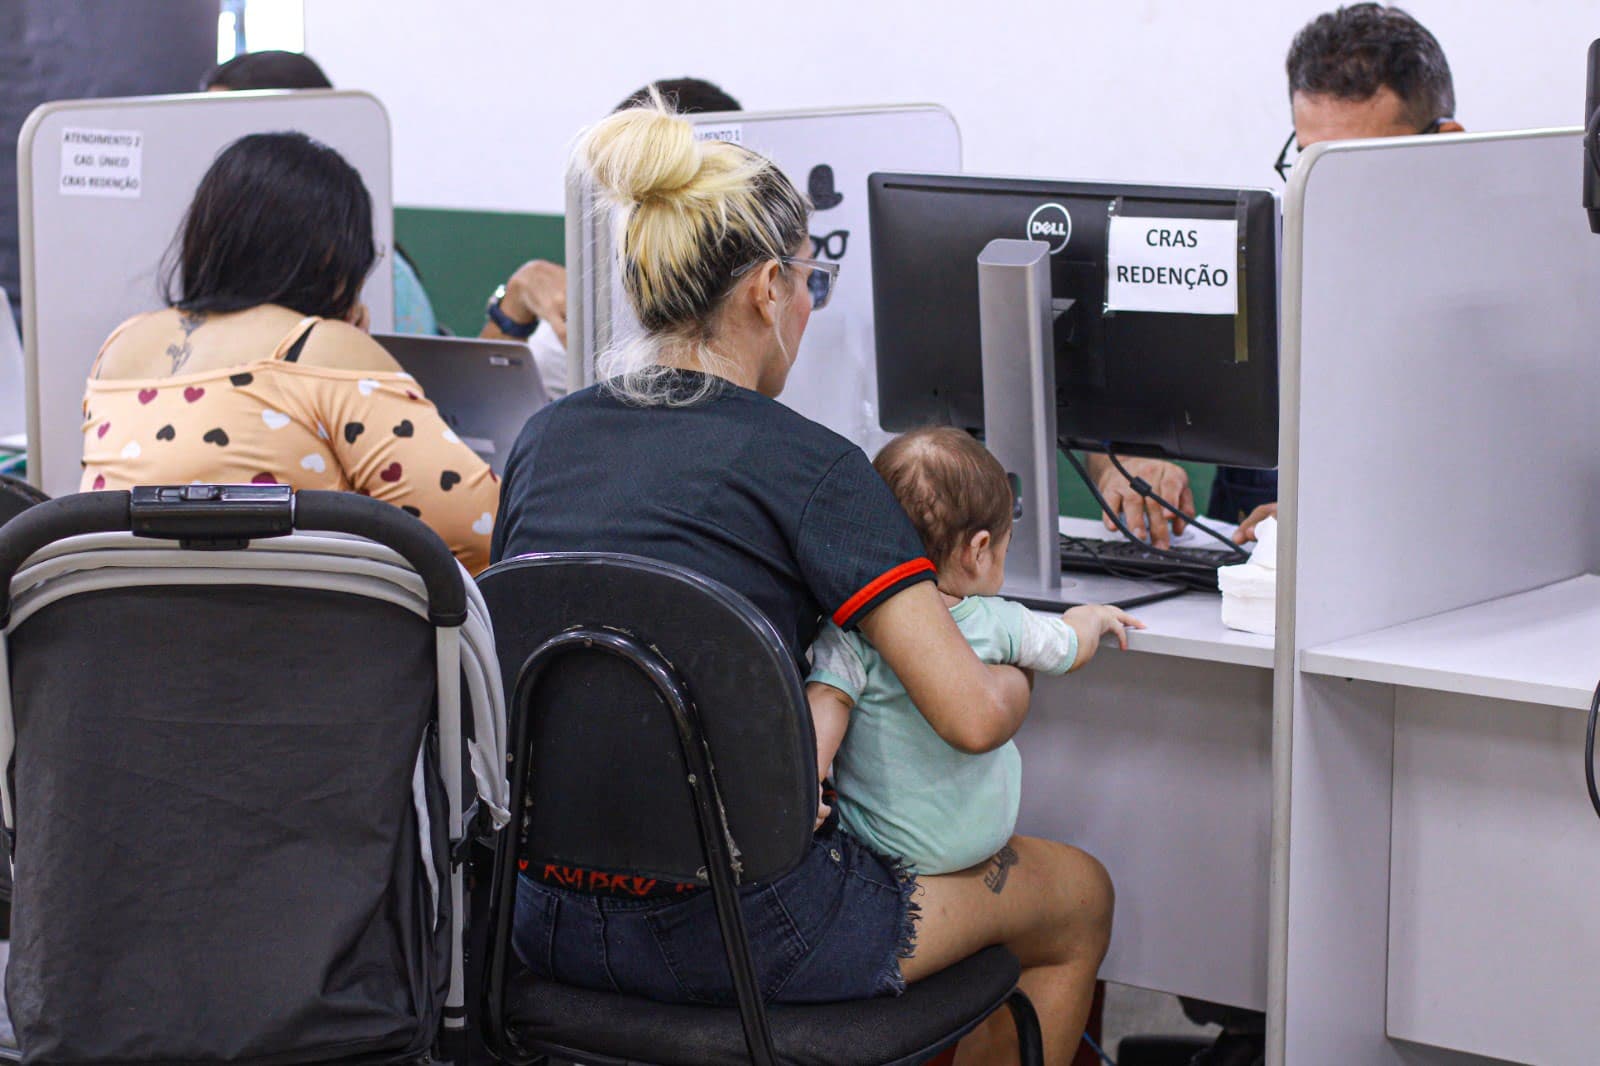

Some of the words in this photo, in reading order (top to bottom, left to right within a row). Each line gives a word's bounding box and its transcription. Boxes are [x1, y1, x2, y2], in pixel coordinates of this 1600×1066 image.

[64, 132, 133, 146] ATENDIMENTO
[62, 175, 86, 187] CRAS
[88, 176, 139, 191] REDENÇÃO
[1032, 221, 1066, 236] DELL
[1146, 228, 1199, 248] CRAS
[1116, 264, 1229, 290] REDENÇÃO
